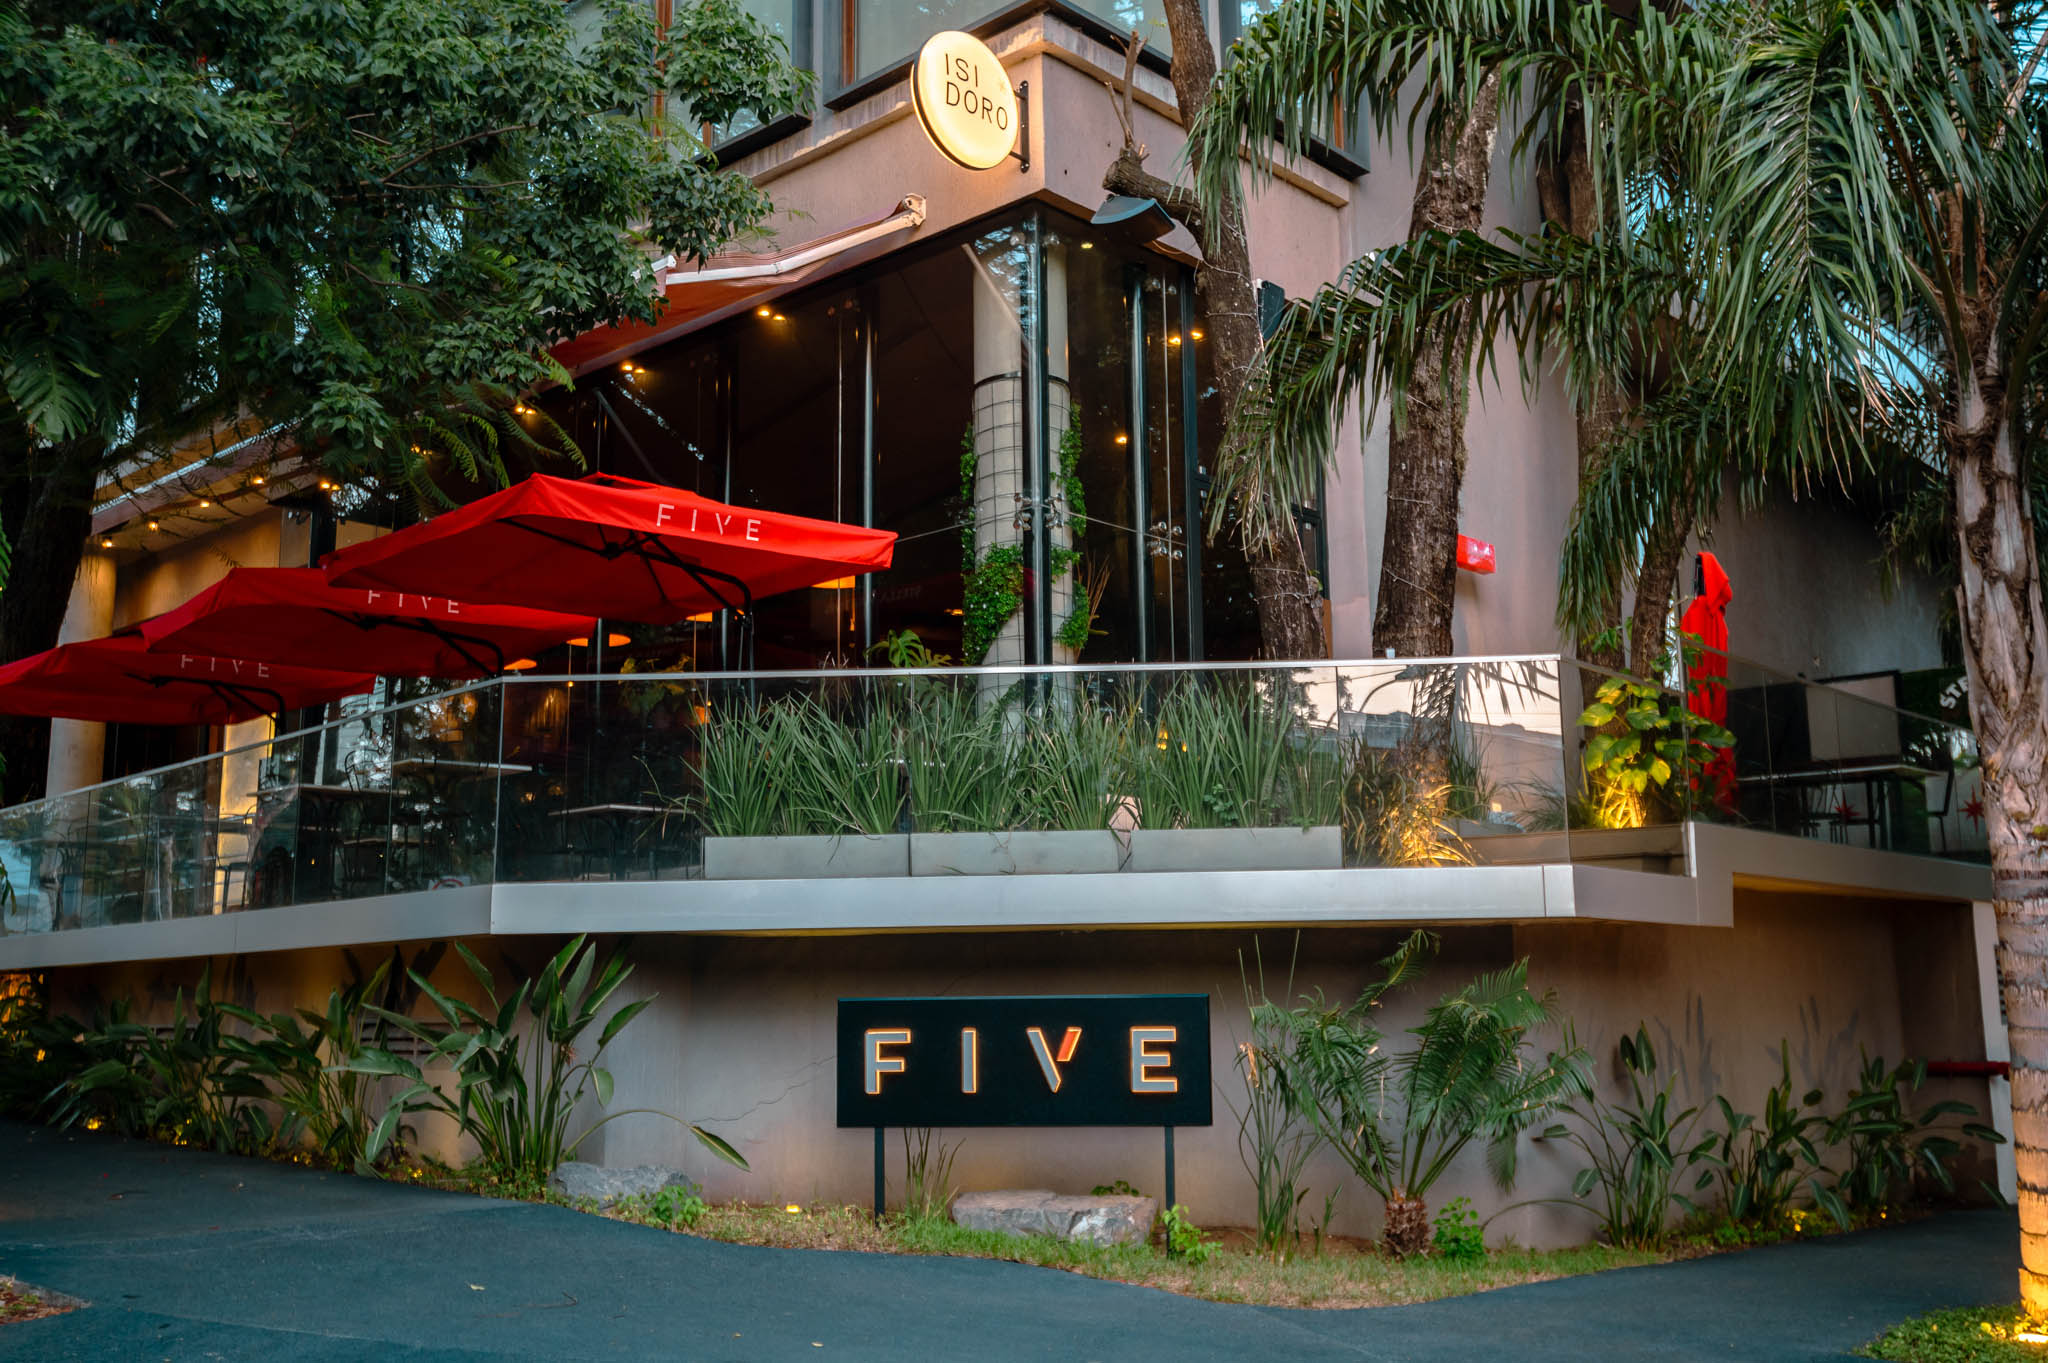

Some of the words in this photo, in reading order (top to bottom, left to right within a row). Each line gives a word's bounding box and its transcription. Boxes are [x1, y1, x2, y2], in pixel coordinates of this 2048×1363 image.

[945, 53, 979, 88] ISI
[946, 81, 1008, 130] DORO
[656, 503, 762, 542] FIVE
[864, 1025, 1179, 1095] FIVE
